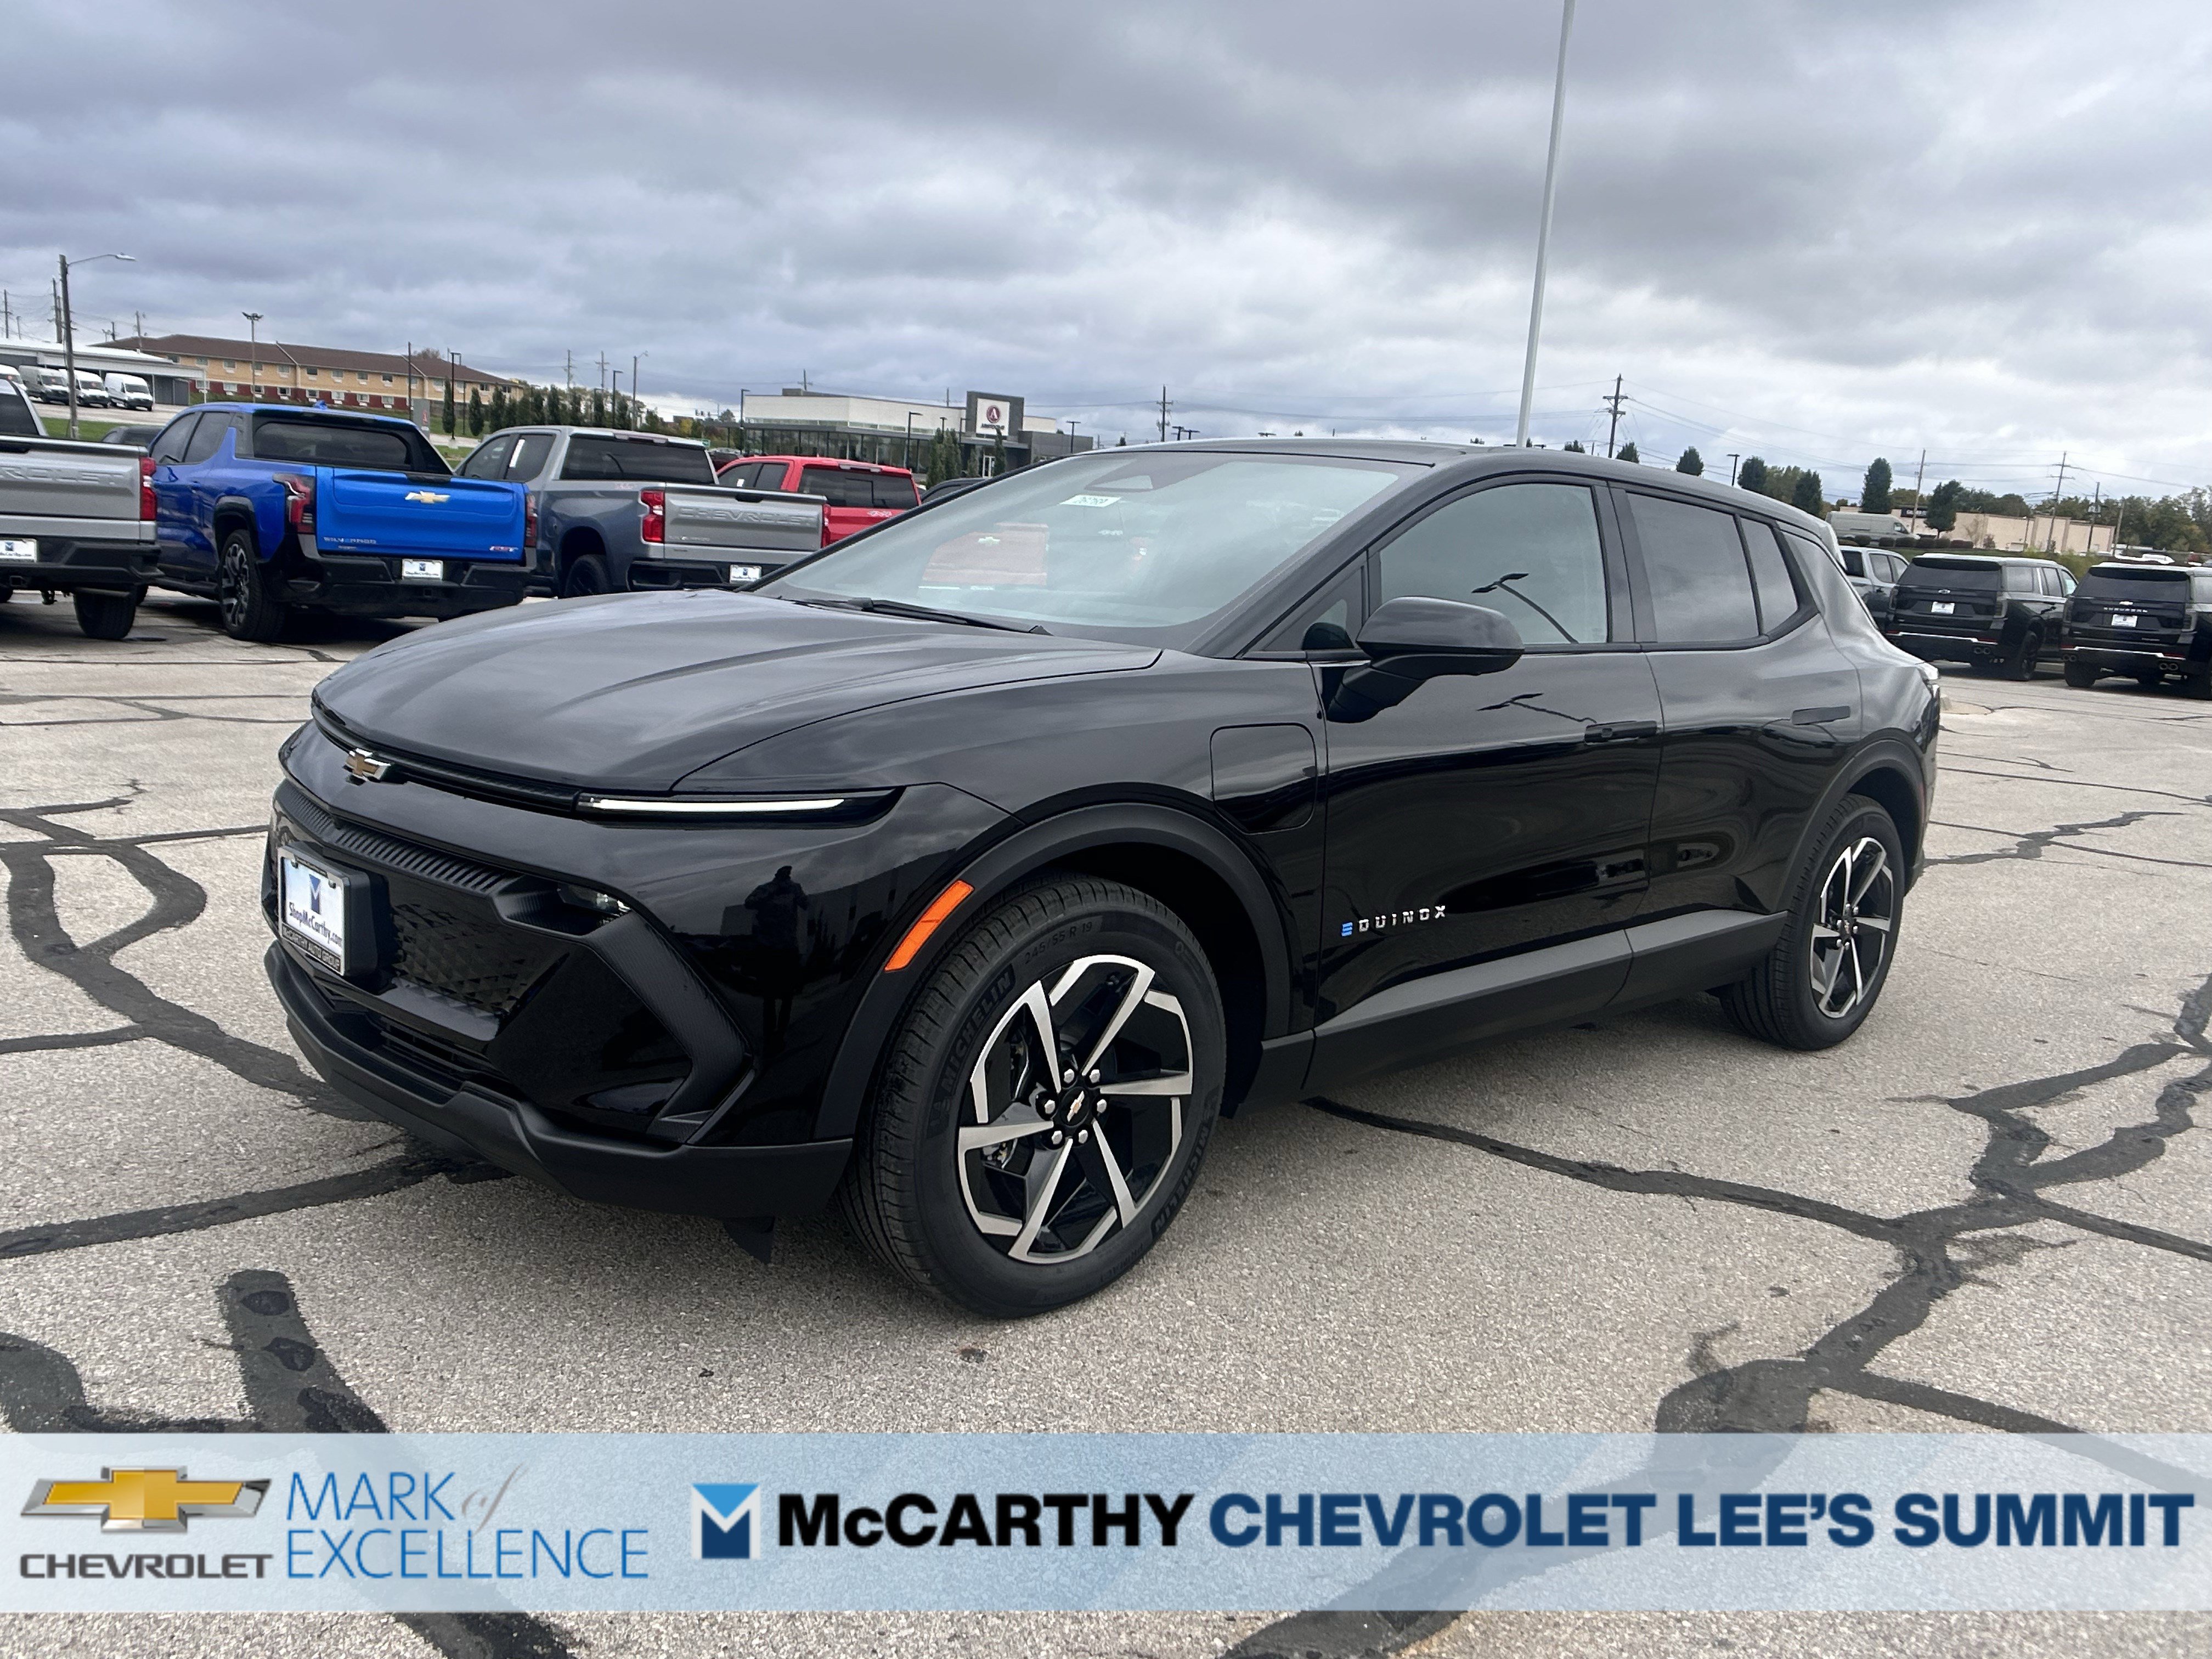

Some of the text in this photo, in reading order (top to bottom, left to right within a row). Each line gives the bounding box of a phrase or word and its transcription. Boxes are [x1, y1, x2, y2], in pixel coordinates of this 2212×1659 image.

[679, 507, 817, 526] CHEVROLET
[1341, 905, 1446, 937] EQUINOX
[940, 972, 1012, 1093] MICHELIN
